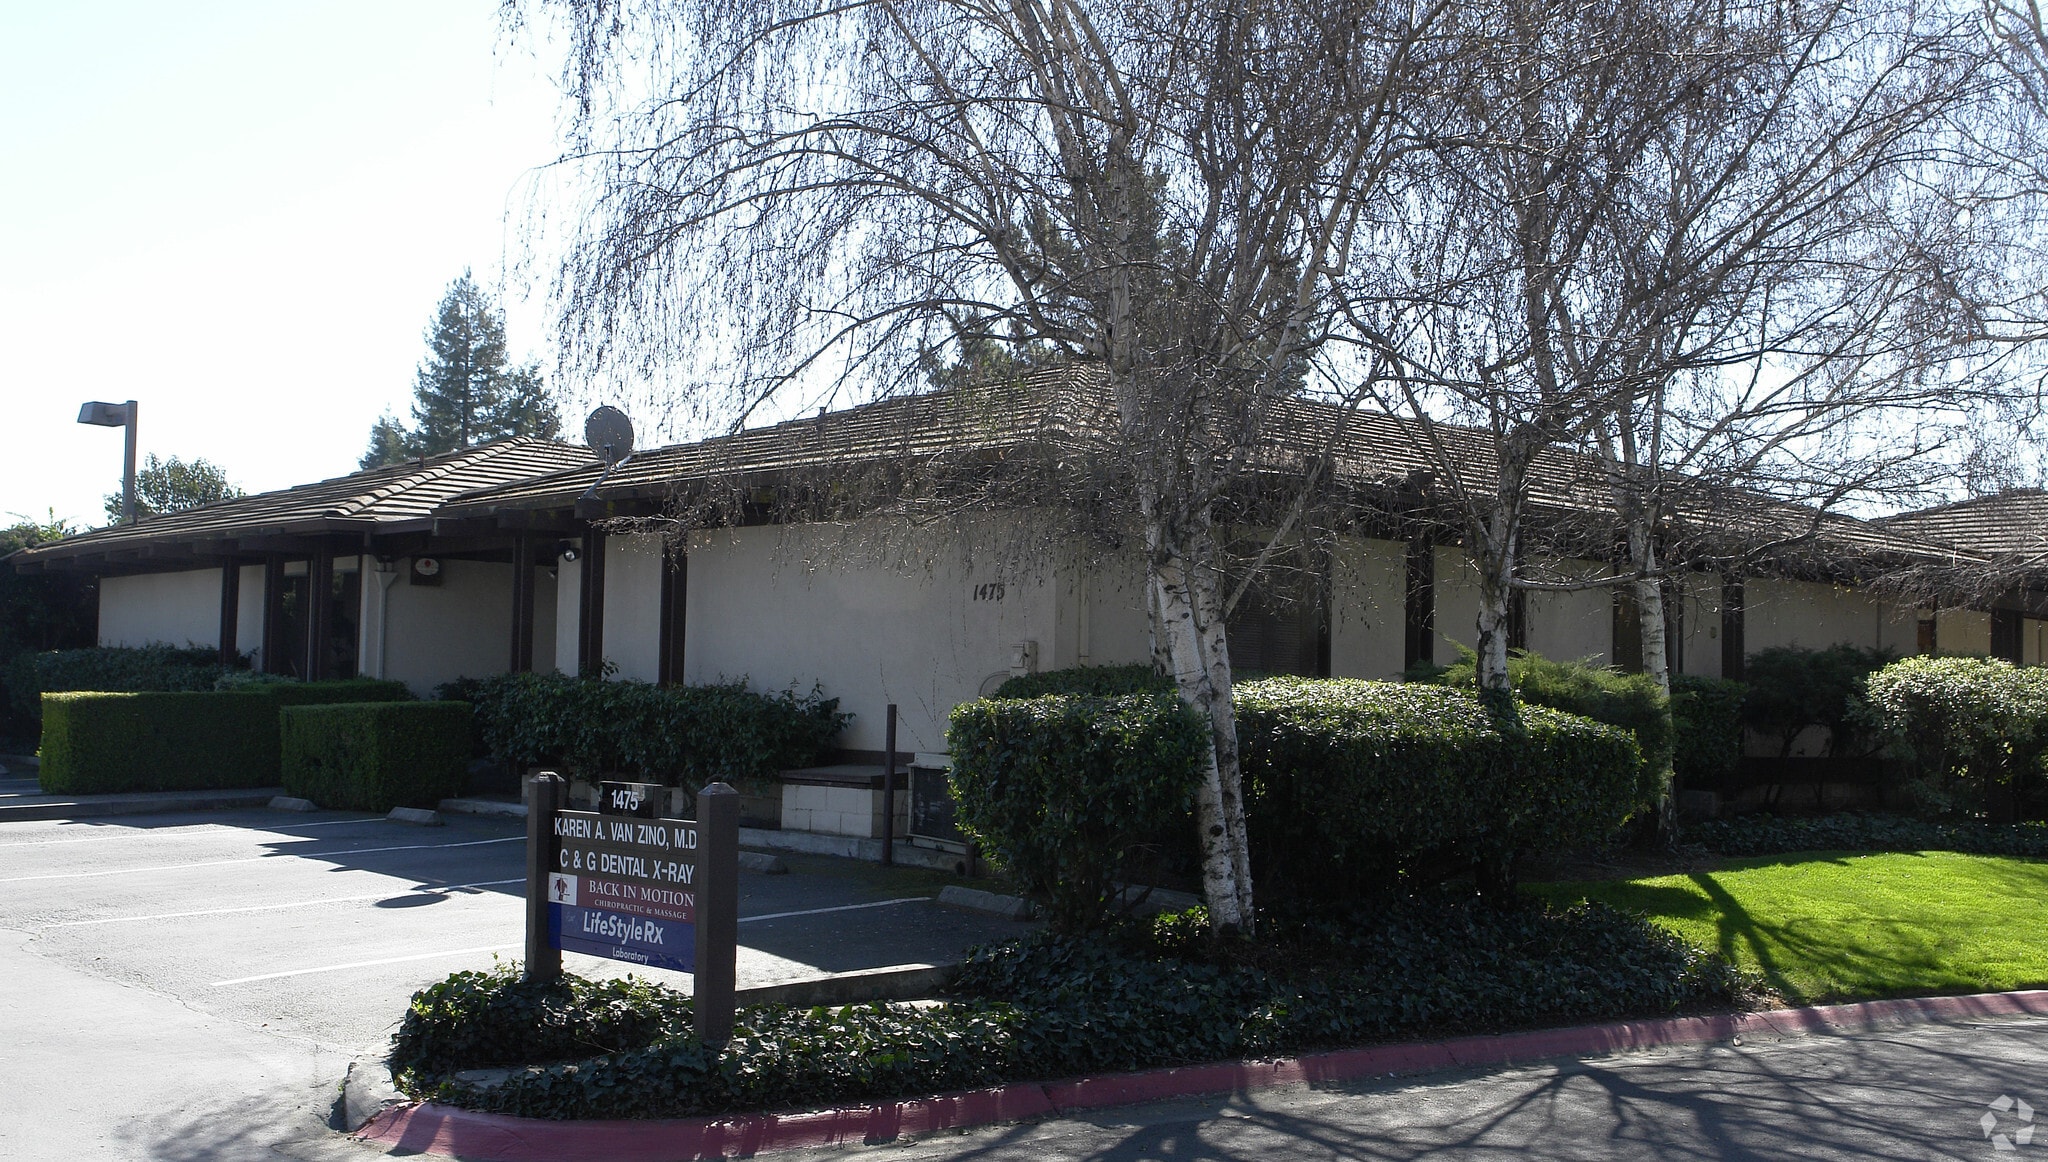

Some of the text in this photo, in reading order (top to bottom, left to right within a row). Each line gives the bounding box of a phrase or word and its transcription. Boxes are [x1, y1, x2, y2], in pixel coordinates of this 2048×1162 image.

[973, 583, 1005, 601] 1475
[612, 789, 638, 810] 1475
[554, 817, 590, 838] KAREN
[595, 821, 606, 840] A.
[611, 822, 632, 842] VAN
[638, 825, 669, 850] ZINO,
[560, 848, 694, 884] C & G DENTAL X-RAY
[589, 880, 694, 907] BACK IN MOTION
[595, 899, 644, 912] CHIROPRACTIC
[654, 908, 687, 919] MASSAGE
[583, 912, 664, 944] LifeStyleRx
[612, 947, 649, 964] Laboratory
